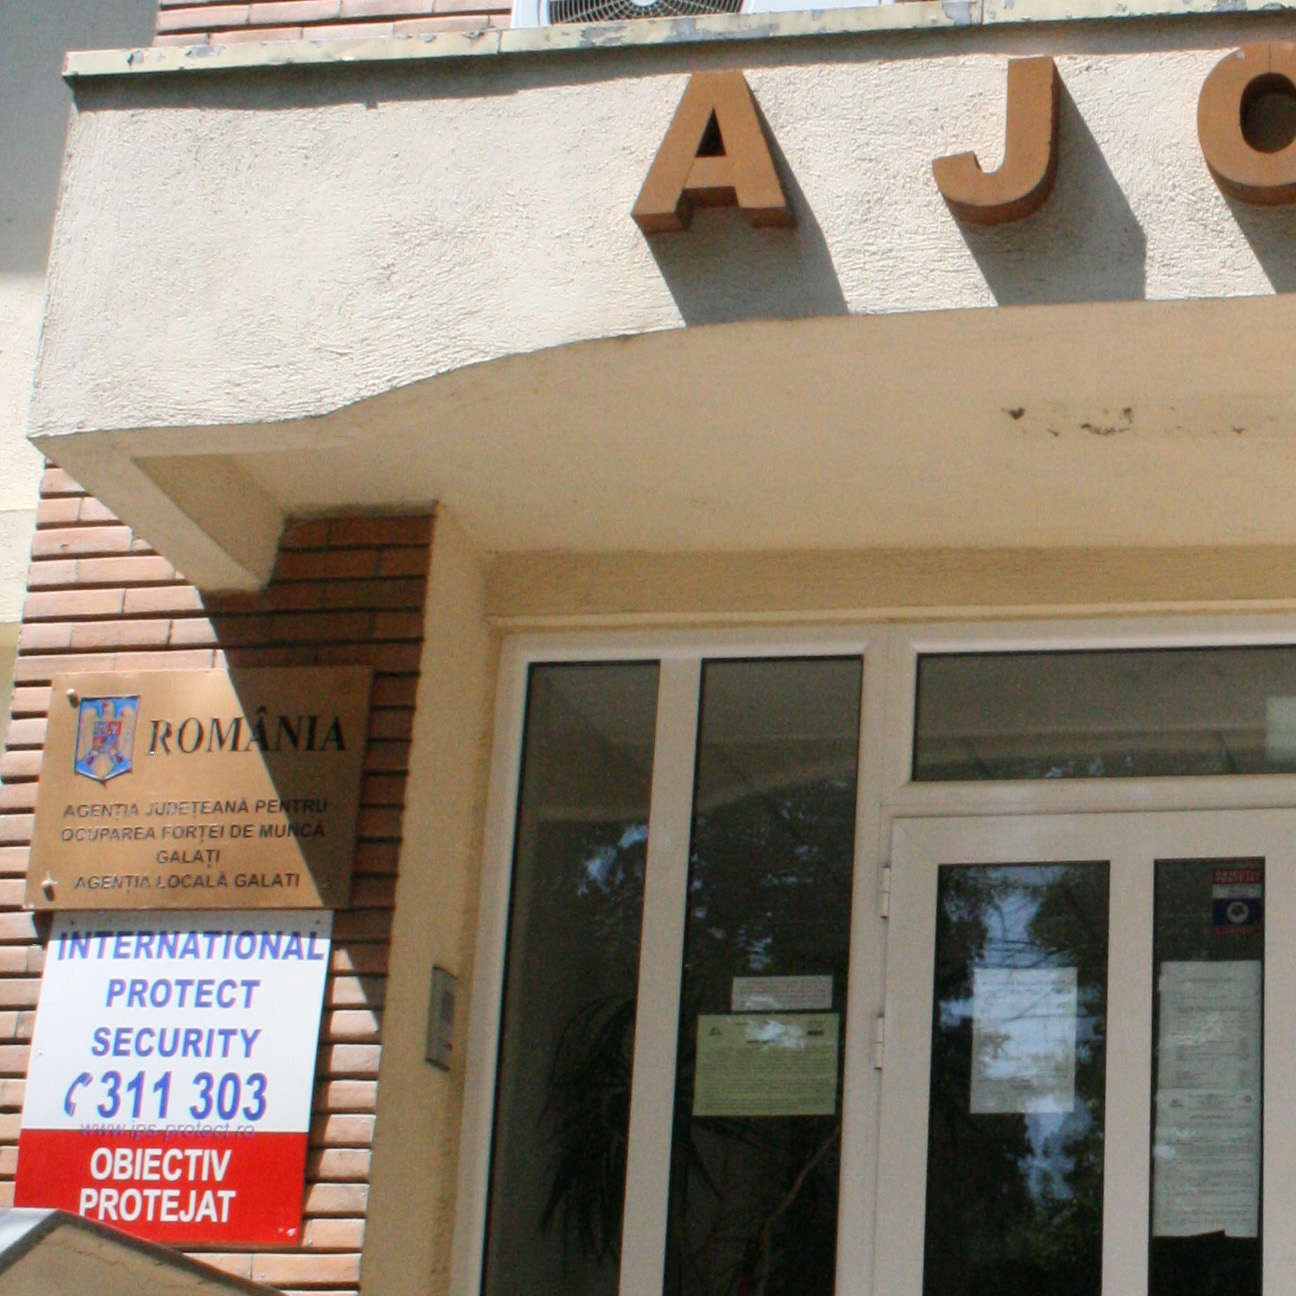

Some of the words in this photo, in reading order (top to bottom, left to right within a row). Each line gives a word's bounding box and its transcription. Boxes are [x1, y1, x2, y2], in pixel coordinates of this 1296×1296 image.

[148, 705, 349, 755] ROMÂNIA
[255, 798, 328, 815] PENTRU
[61, 825, 155, 842] OCUPAREA
[229, 823, 253, 839] DE
[58, 930, 325, 960] INTERNATIONAL
[105, 978, 261, 1009] PROTECT
[91, 1026, 262, 1058] SECURITY
[97, 1070, 172, 1119] 311
[189, 1071, 267, 1122] 303
[80, 1119, 256, 1141] www.ips-protect.ro
[90, 1146, 232, 1182] OBIECTIV
[79, 1187, 236, 1224] PROTEJAT
